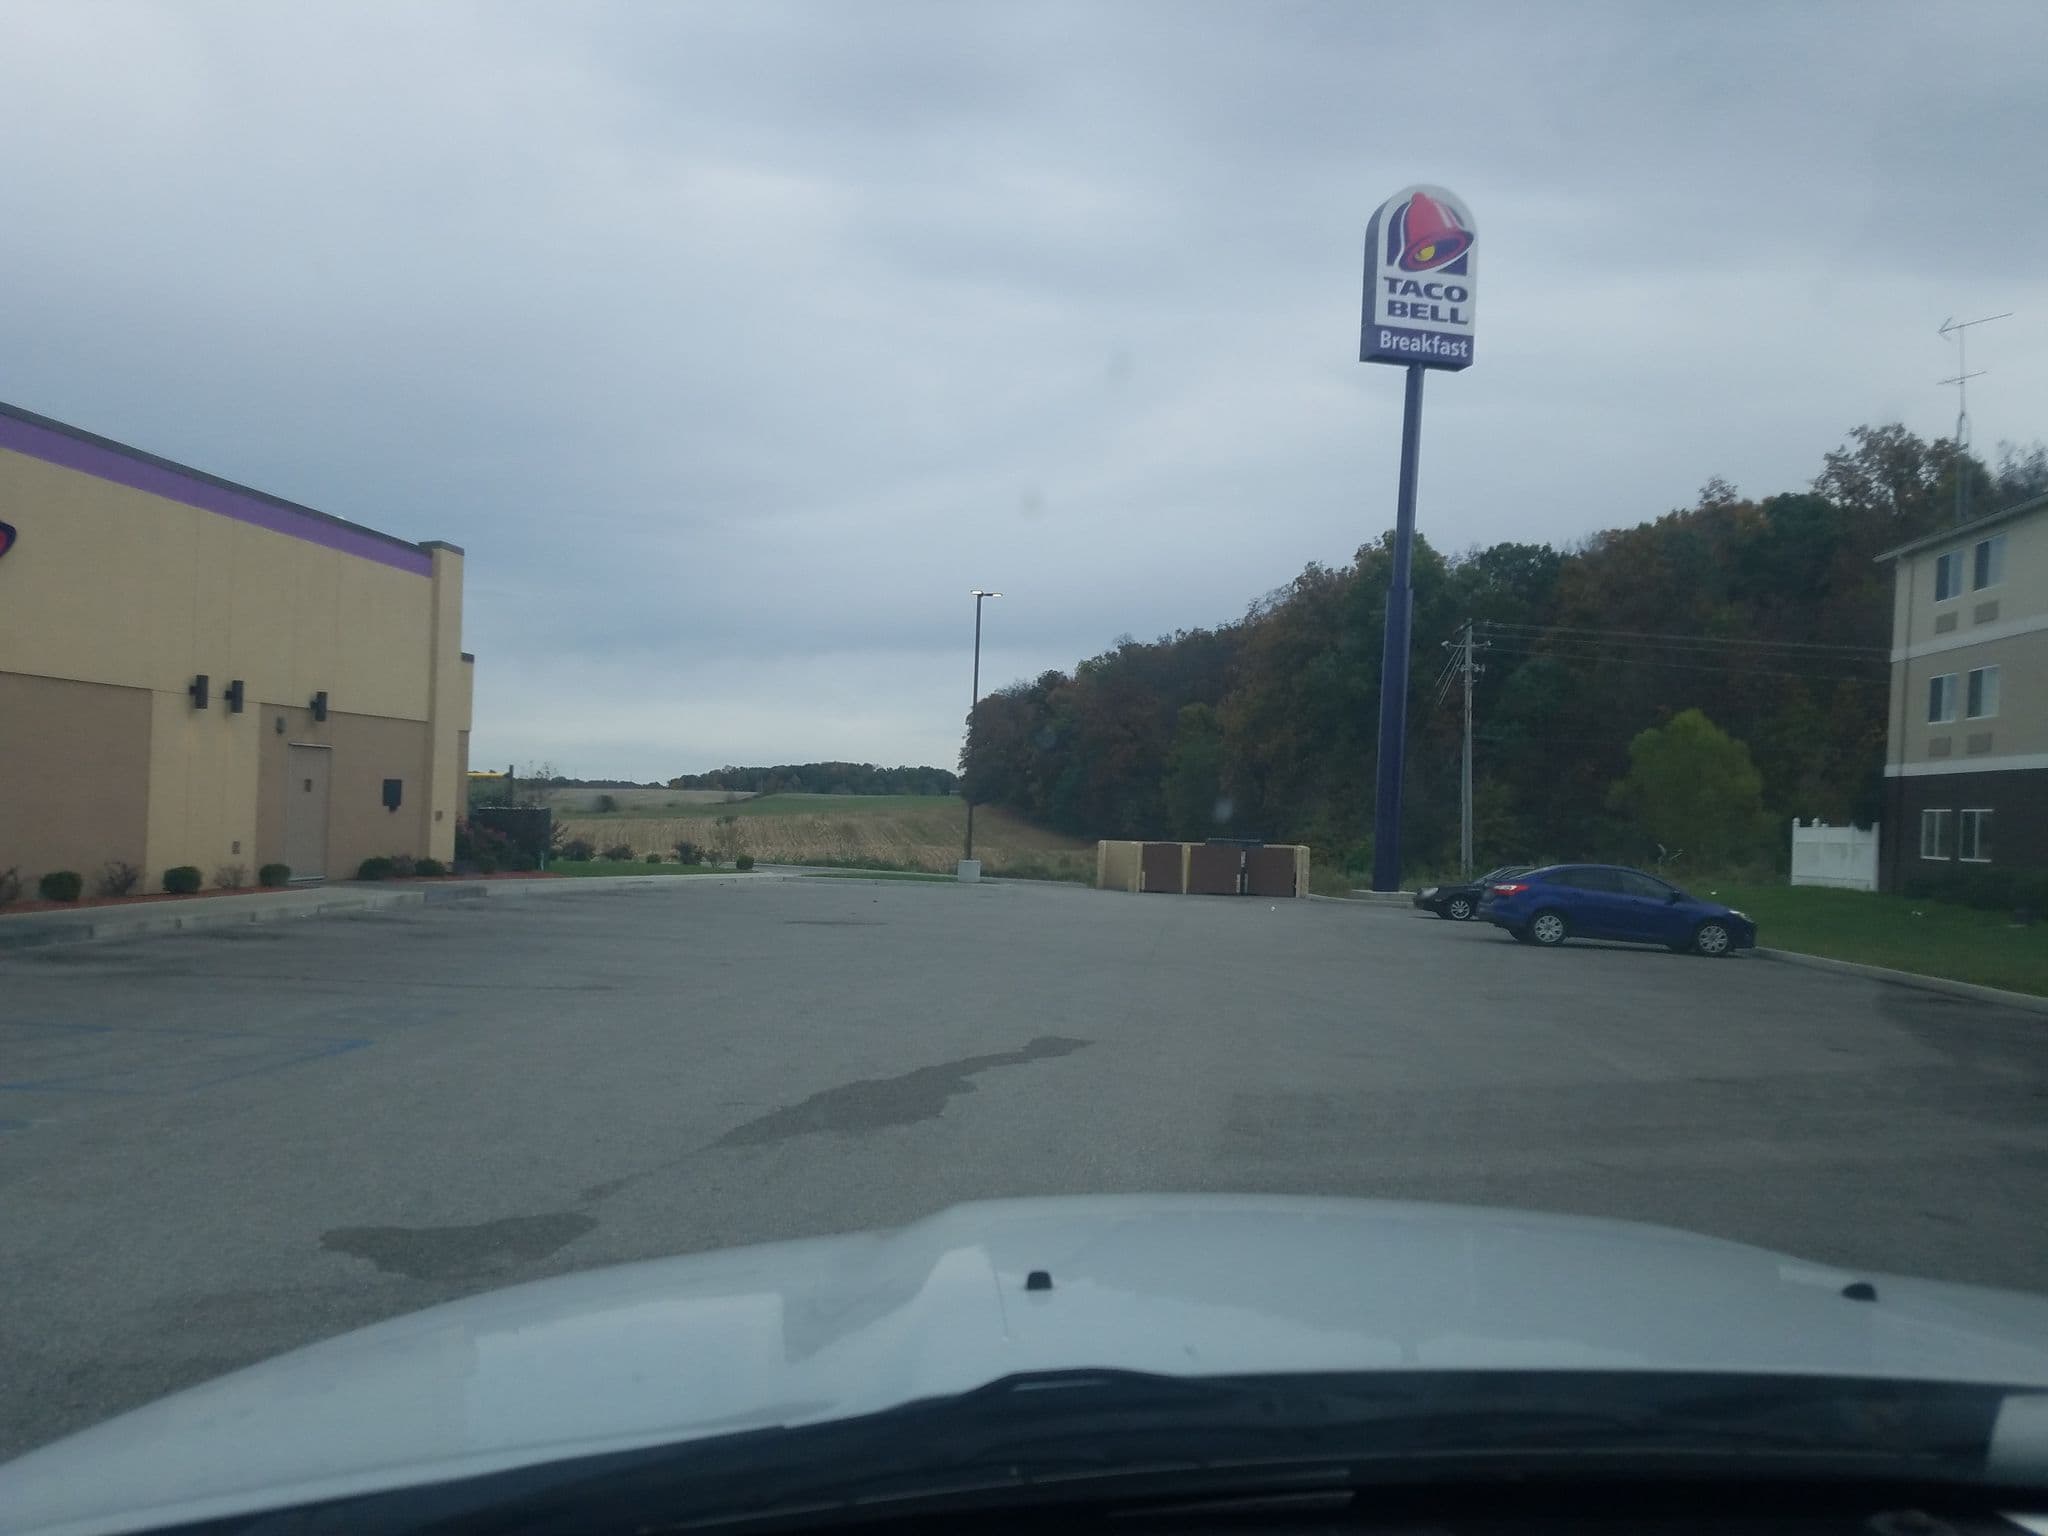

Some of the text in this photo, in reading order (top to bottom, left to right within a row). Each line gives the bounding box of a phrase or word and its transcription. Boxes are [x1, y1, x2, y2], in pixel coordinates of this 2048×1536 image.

[1383, 276, 1468, 302] TACO
[1387, 300, 1468, 324] BELL
[1380, 330, 1468, 357] Breakfast
